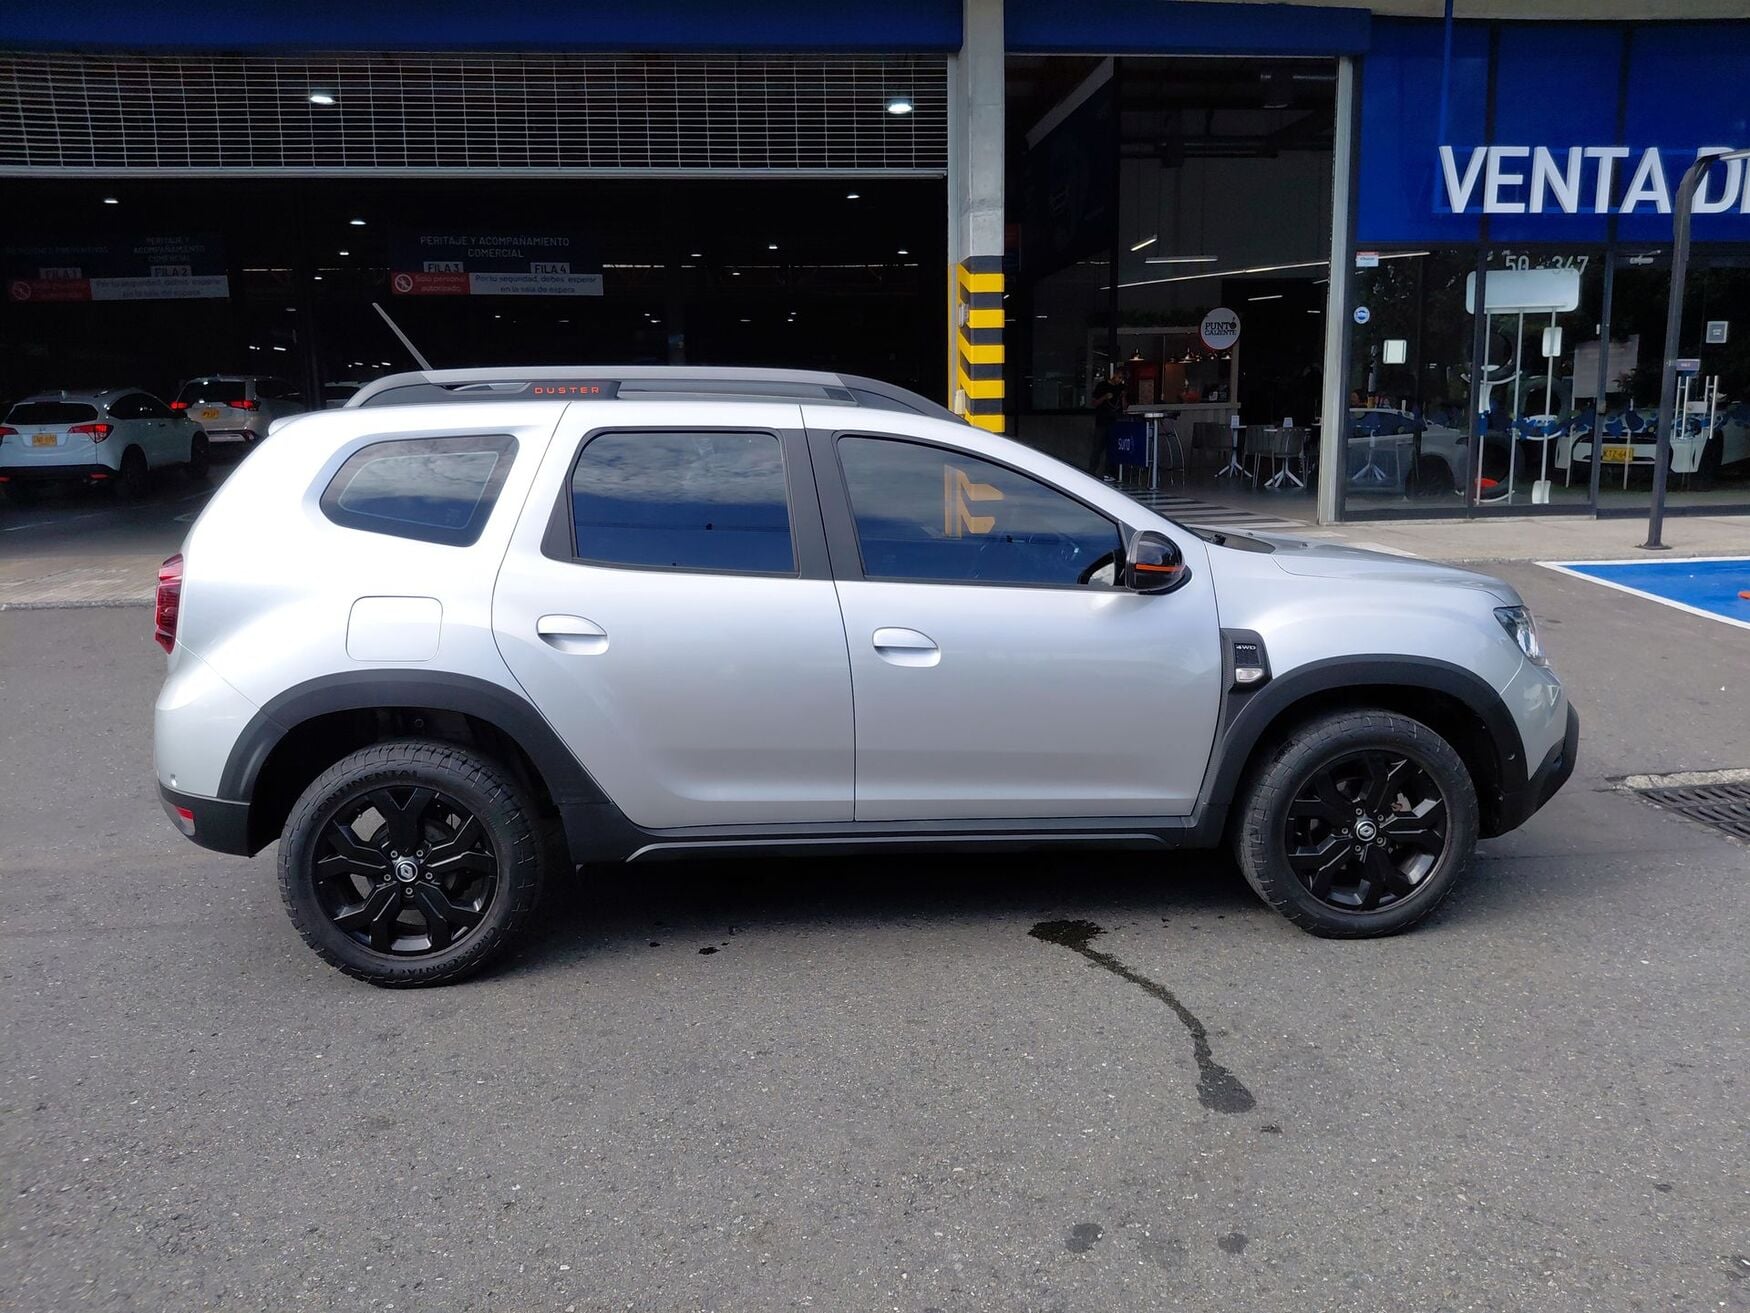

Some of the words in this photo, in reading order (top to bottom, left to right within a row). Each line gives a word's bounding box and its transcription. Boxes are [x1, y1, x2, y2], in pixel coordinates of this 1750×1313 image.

[1438, 146, 1672, 213] VENTA
[1692, 146, 1750, 213] D
[420, 236, 468, 246] PERITAJE
[479, 235, 570, 247] ACOMPAÑAMIENTO
[467, 248, 525, 258] COMERCIAL
[428, 263, 452, 273] FILA
[534, 264, 557, 274] FILA
[1204, 320, 1237, 330] PUNTO
[534, 386, 600, 395] DUSTER
[311, 769, 420, 821] CONTINENTAL
